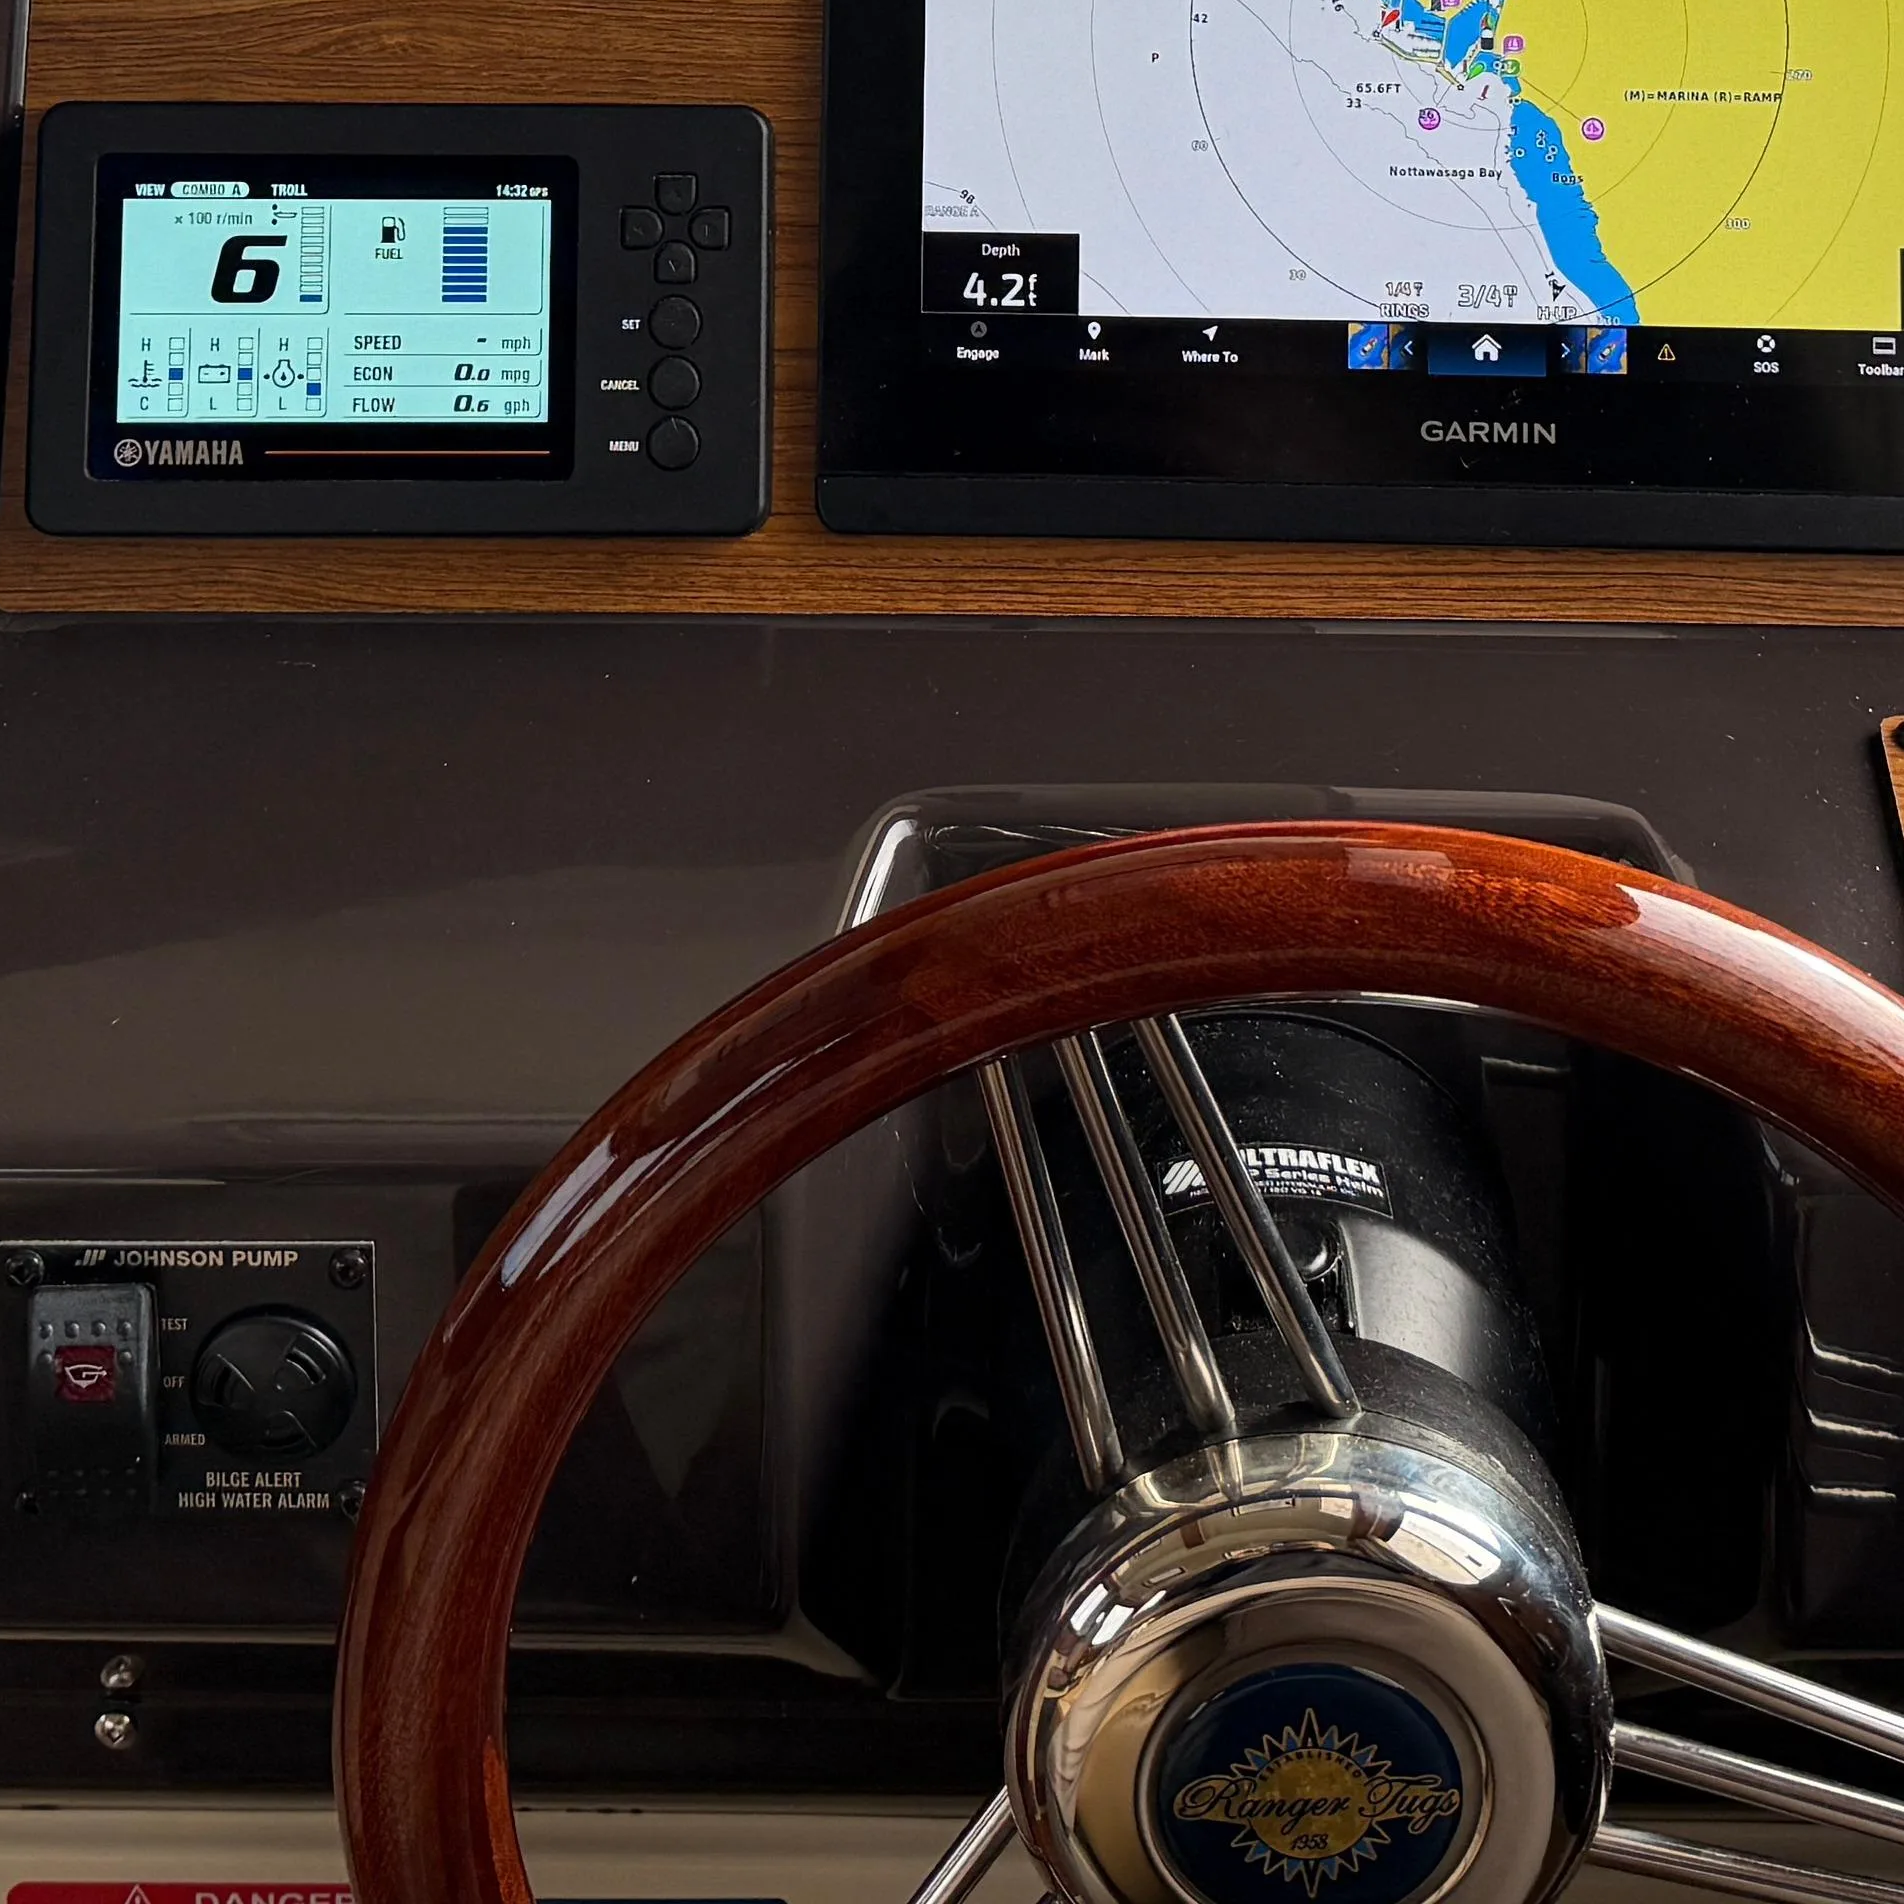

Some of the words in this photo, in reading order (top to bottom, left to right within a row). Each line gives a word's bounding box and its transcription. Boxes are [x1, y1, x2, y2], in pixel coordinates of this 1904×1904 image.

[1151, 52, 1160, 63] P
[1356, 83, 1401, 94] 65.6FT
[1346, 98, 1362, 108] 33
[1389, 165, 1474, 180] Nottawasaga
[1479, 167, 1502, 181] Bay
[135, 183, 165, 196] VIEW
[182, 184, 226, 196] COMBO
[232, 184, 241, 196] A
[271, 183, 308, 196] TROLL
[495, 184, 528, 198] 14:32
[187, 210, 213, 226] 100
[216, 210, 253, 226] r/min
[375, 248, 403, 261] FUEL
[981, 243, 1020, 258] Depth
[211, 234, 287, 304] 6
[963, 272, 1025, 306] 4.2
[1379, 304, 1430, 318] RINGS
[621, 319, 641, 330] SET
[141, 338, 151, 352] H
[210, 338, 220, 352] H
[279, 338, 289, 352] H
[353, 335, 402, 351] SPEED
[501, 336, 531, 353] mph
[956, 347, 1000, 362] Engage
[1079, 348, 1110, 361] Mark
[1181, 350, 1220, 364] Where
[1223, 351, 1238, 364] To
[353, 366, 393, 382] ECON
[453, 363, 490, 383] 0.0
[500, 368, 530, 384] mpg
[1753, 361, 1779, 374] SOS
[600, 380, 640, 391] CANCEL
[140, 397, 149, 411] C
[210, 397, 217, 411] L
[279, 397, 287, 411] L
[352, 397, 395, 413] FLOW
[453, 394, 490, 413] 0.6
[505, 397, 530, 415] gph
[1421, 421, 1557, 446] GARMIN
[144, 440, 244, 466] YAMAHA
[609, 440, 639, 452] MENU
[1266, 1167, 1331, 1184] Series
[1335, 1175, 1385, 1198] Helm
[114, 1250, 224, 1267] JOHNSON
[233, 1250, 299, 1267] PUMP
[161, 1318, 187, 1331] TEST
[163, 1376, 185, 1389] OFF
[164, 1433, 206, 1446] ARMED
[205, 1471, 250, 1487] BILGE
[255, 1471, 301, 1487] ALERT
[178, 1493, 216, 1509] HIGH
[222, 1493, 272, 1509] WATER
[277, 1493, 330, 1509] ALARM
[1178, 1777, 1350, 1836] Ranger
[1358, 1776, 1458, 1833] Tugs
[1291, 1833, 1329, 1851] 1958
